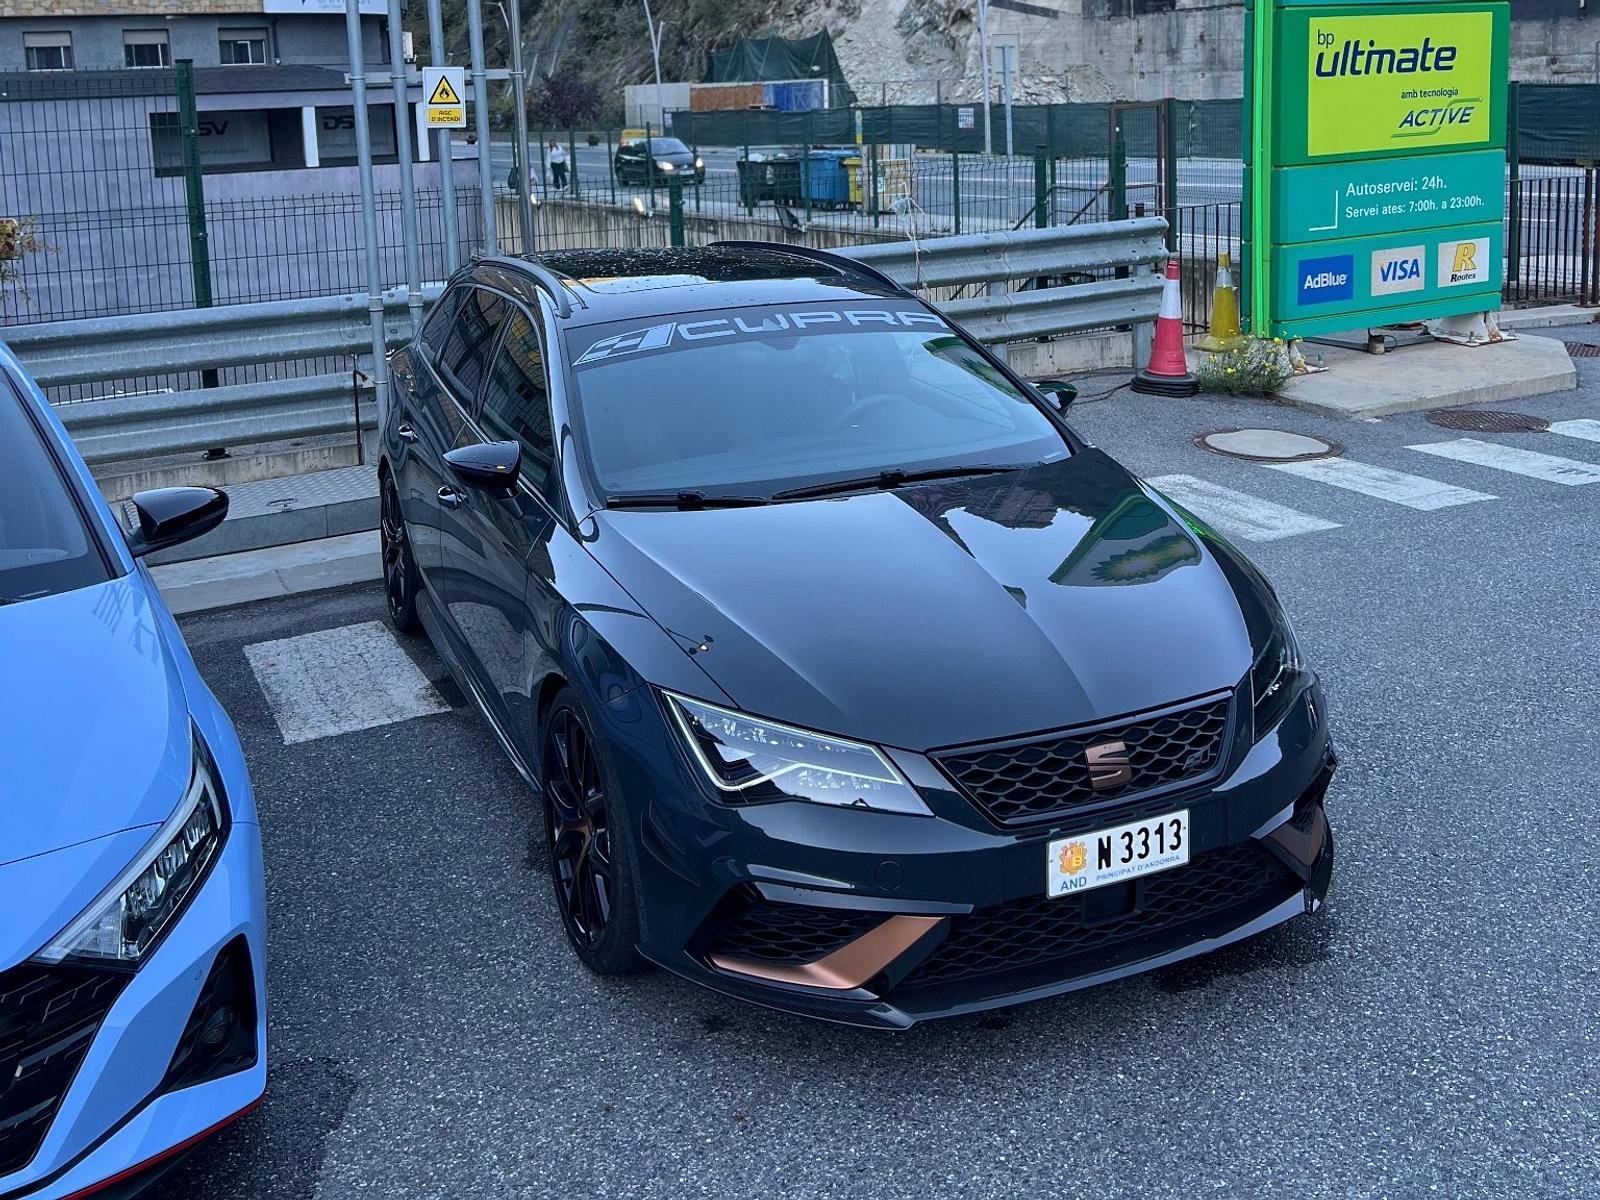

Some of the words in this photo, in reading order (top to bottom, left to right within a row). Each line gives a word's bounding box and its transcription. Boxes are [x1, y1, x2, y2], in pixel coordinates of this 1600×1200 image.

[1317, 29, 1335, 48] bp
[1315, 37, 1457, 77] ultimate
[1401, 88, 1418, 99] amb
[1420, 87, 1459, 98] tecnologia
[323, 113, 369, 131] DS
[1398, 106, 1475, 129] ACTIVE
[1346, 177, 1418, 197] Autoservei:
[1421, 175, 1448, 191] 24h.
[1345, 204, 1379, 218] Servei
[1381, 205, 1406, 216] ates:
[1408, 198, 1439, 213] 7:00h.
[1441, 200, 1448, 210] a
[1450, 195, 1485, 209] 23:00h.
[1380, 258, 1420, 283] VISA
[1450, 271, 1477, 283] Routex
[677, 310, 950, 341] CUPRA
[1097, 835, 1112, 870] N
[1120, 818, 1182, 864] 3313
[1096, 865, 1135, 882] PRINCIPAT
[1137, 855, 1181, 871] D'ANDORRA
[1060, 876, 1087, 892] AND
